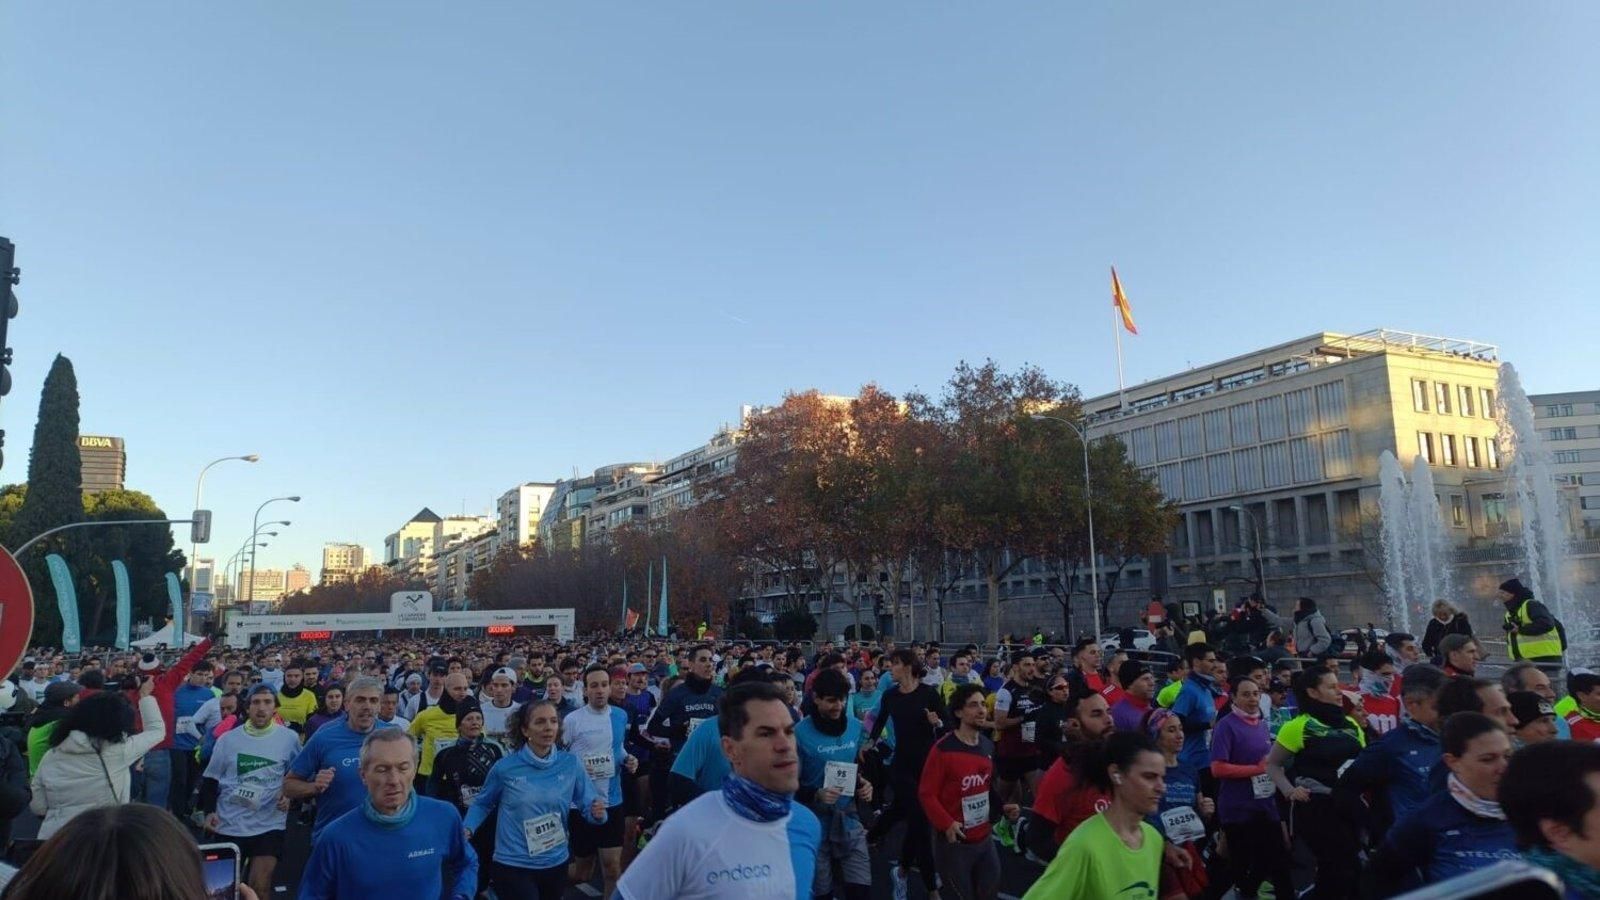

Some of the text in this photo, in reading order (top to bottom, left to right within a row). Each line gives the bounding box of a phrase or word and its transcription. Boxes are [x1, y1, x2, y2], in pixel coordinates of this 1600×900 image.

[81, 437, 112, 447] BBVA
[588, 756, 610, 765] 11904
[836, 769, 848, 778] 95
[238, 788, 255, 798] 1133
[1168, 813, 1195, 826] 26259
[535, 820, 555, 835] 8114
[706, 864, 770, 885] endesa
